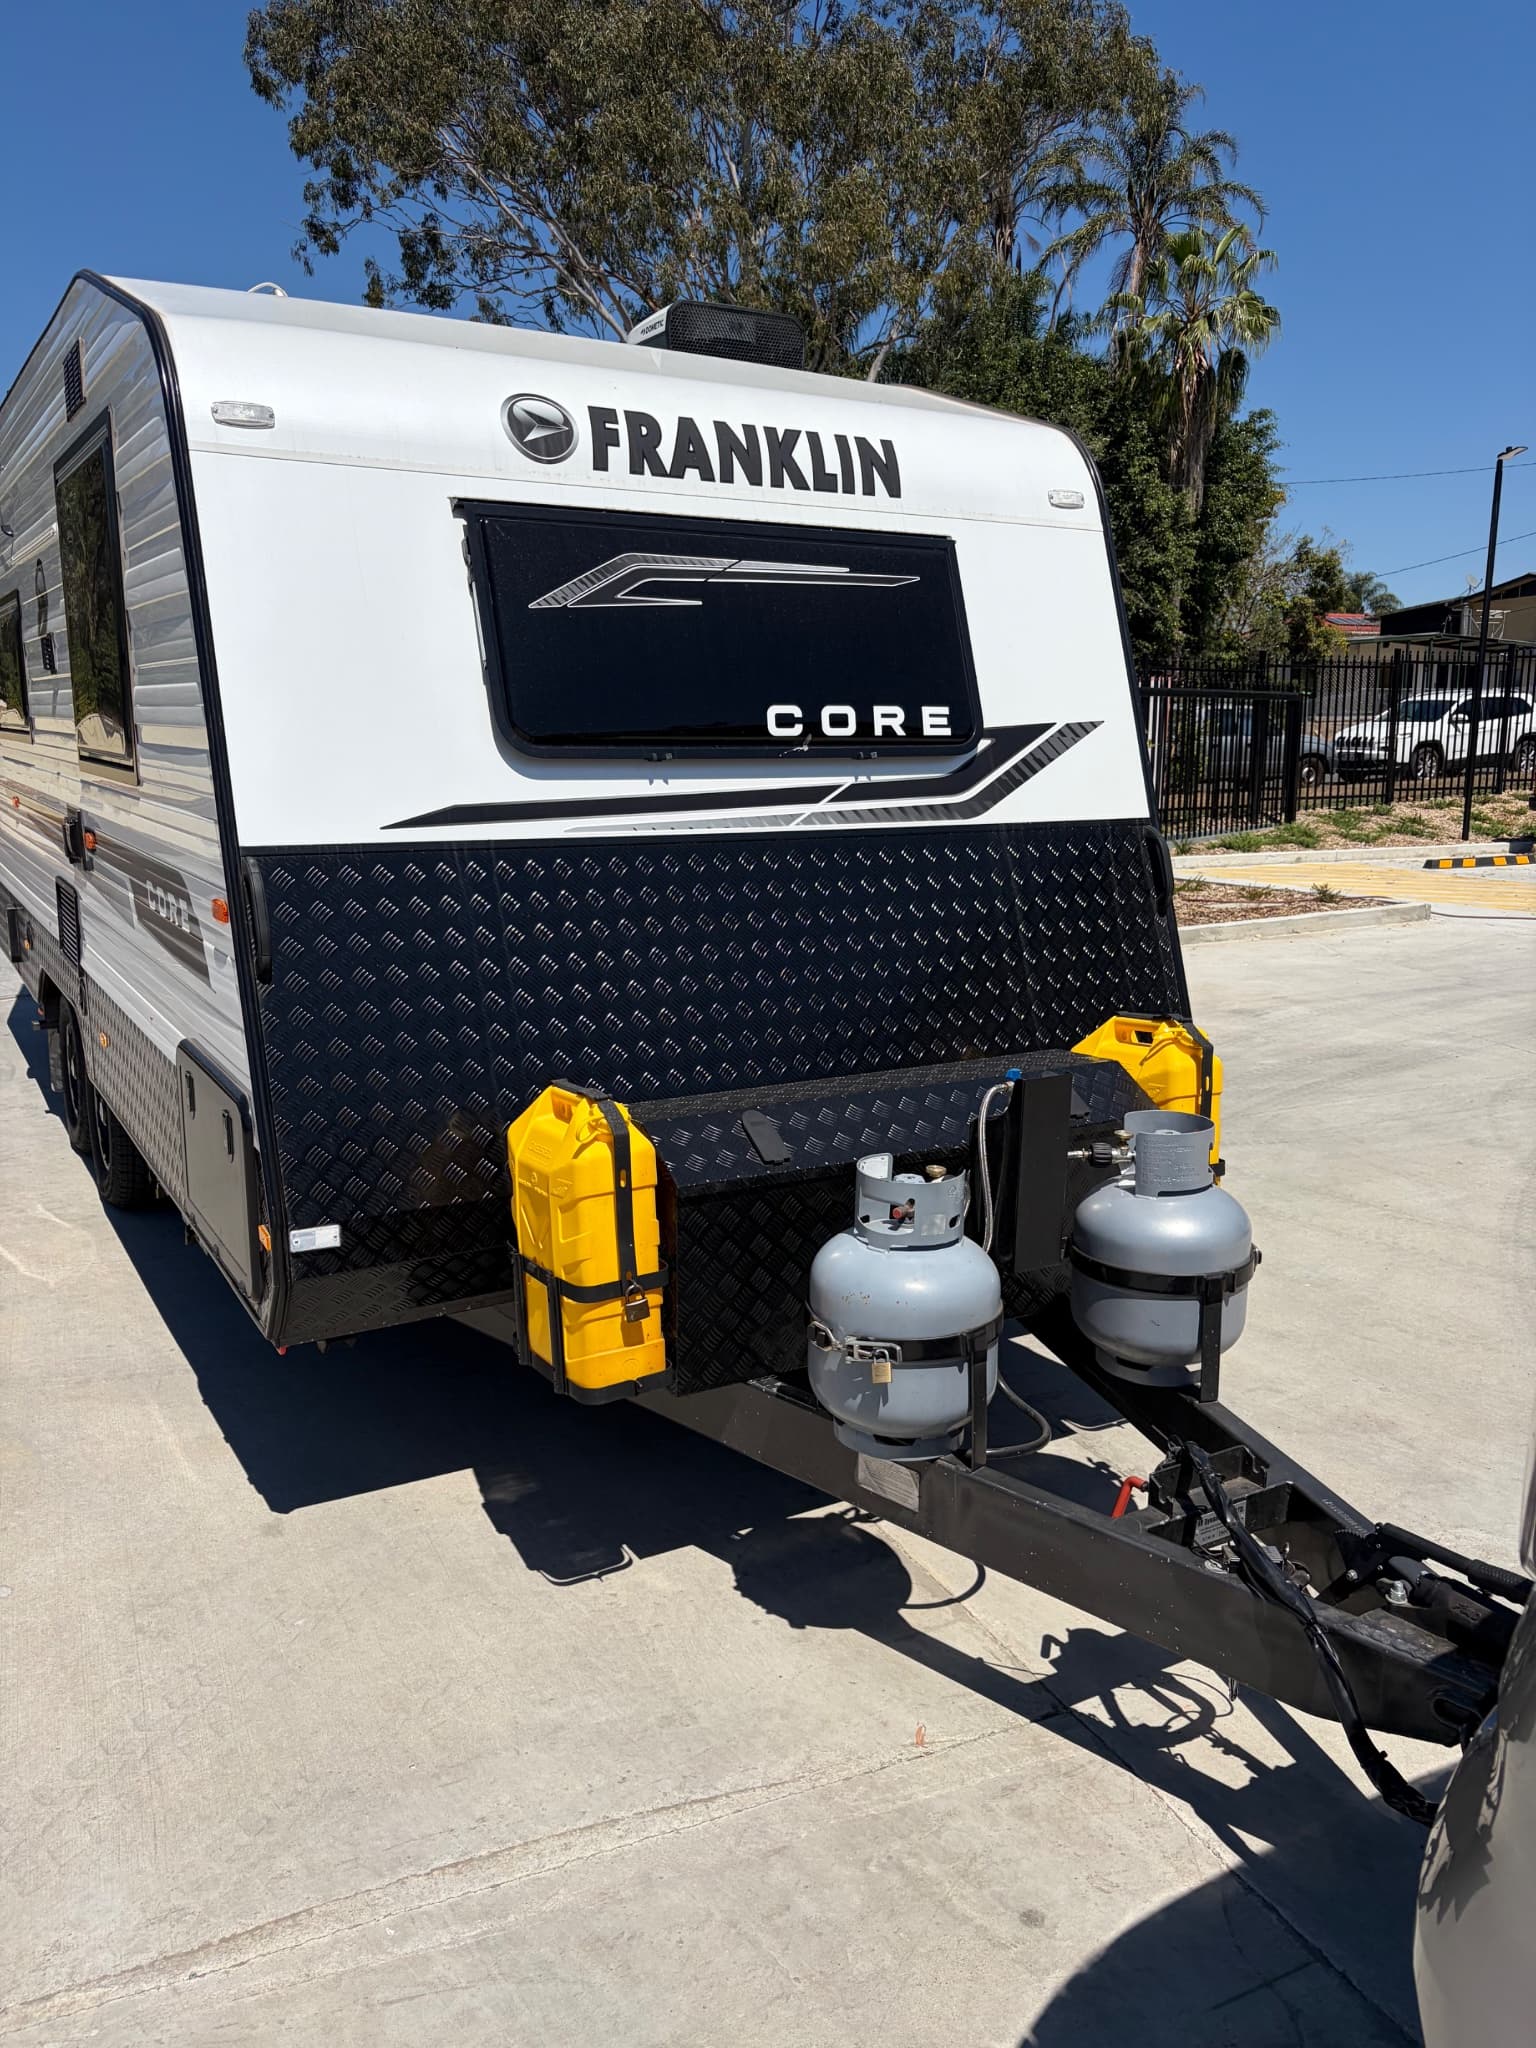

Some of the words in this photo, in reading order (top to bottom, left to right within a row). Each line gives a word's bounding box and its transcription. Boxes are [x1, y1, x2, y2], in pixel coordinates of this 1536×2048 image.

[645, 319, 664, 334] DOMETIC
[587, 405, 902, 499] FRANKLIN
[766, 704, 952, 737] CORE
[146, 880, 190, 933] CORE
